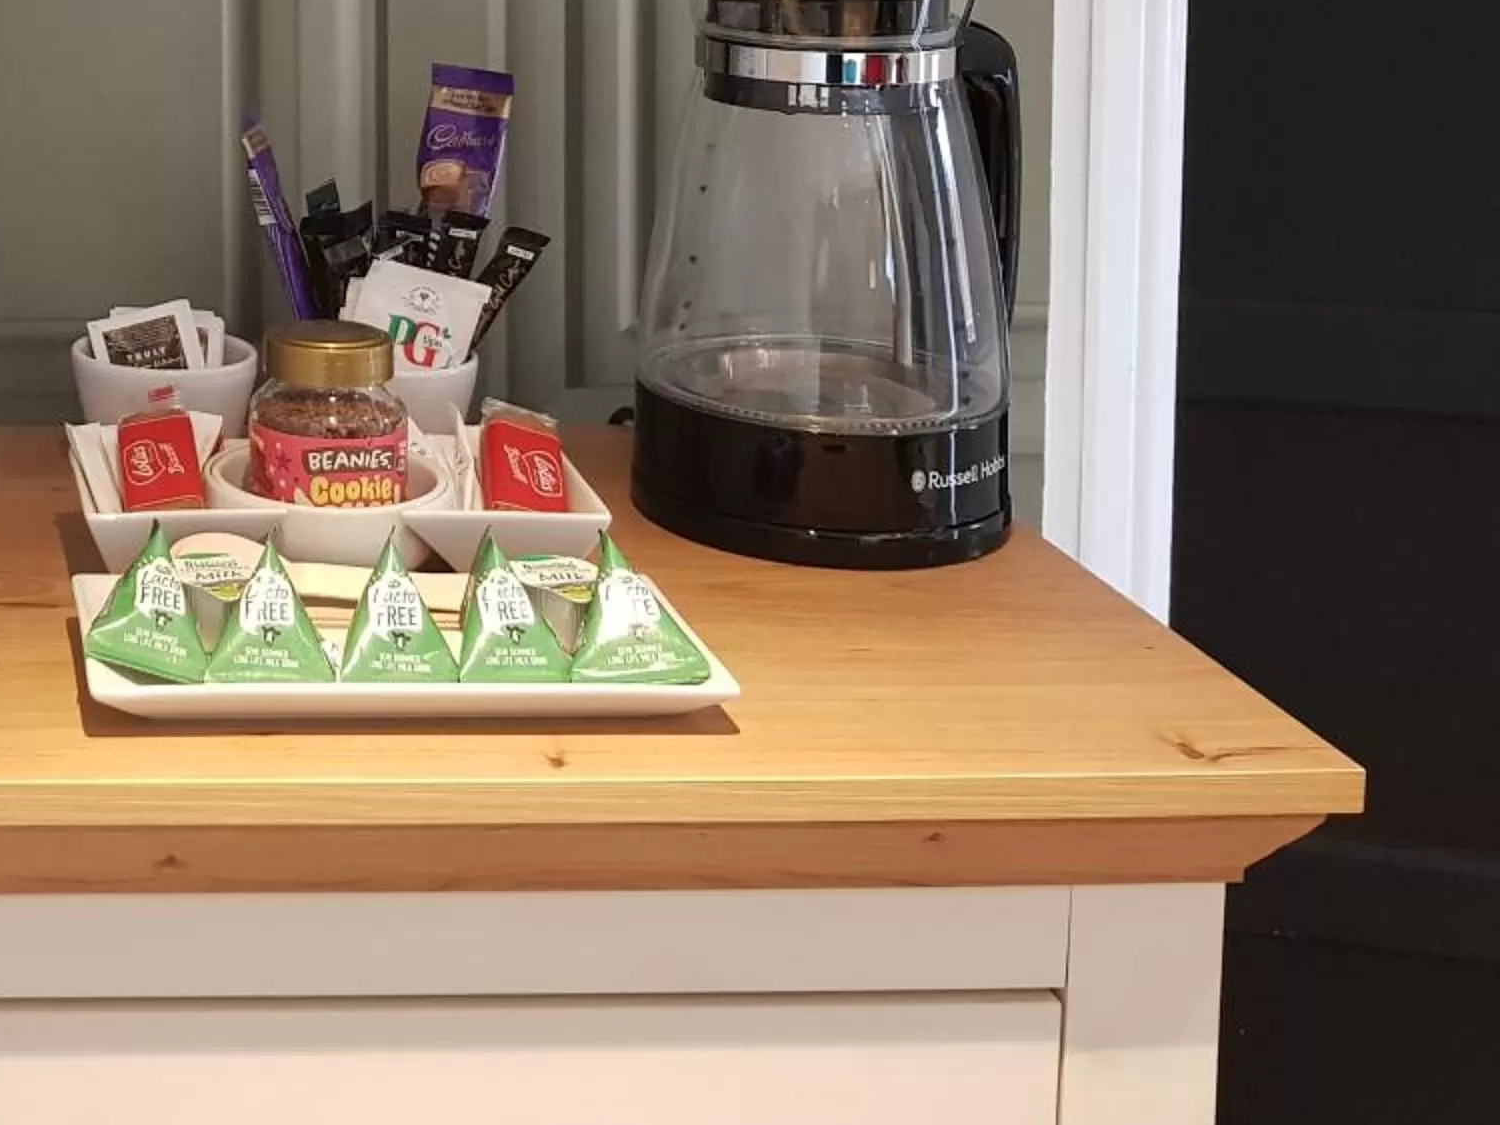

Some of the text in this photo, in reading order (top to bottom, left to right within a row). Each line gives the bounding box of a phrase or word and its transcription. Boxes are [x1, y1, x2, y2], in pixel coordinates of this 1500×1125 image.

[125, 346, 167, 361] TRULY
[388, 314, 441, 368] PG
[307, 449, 391, 472] BEANIES
[928, 463, 979, 489] Russell
[310, 475, 392, 505] Cookie
[140, 586, 181, 610] FREE
